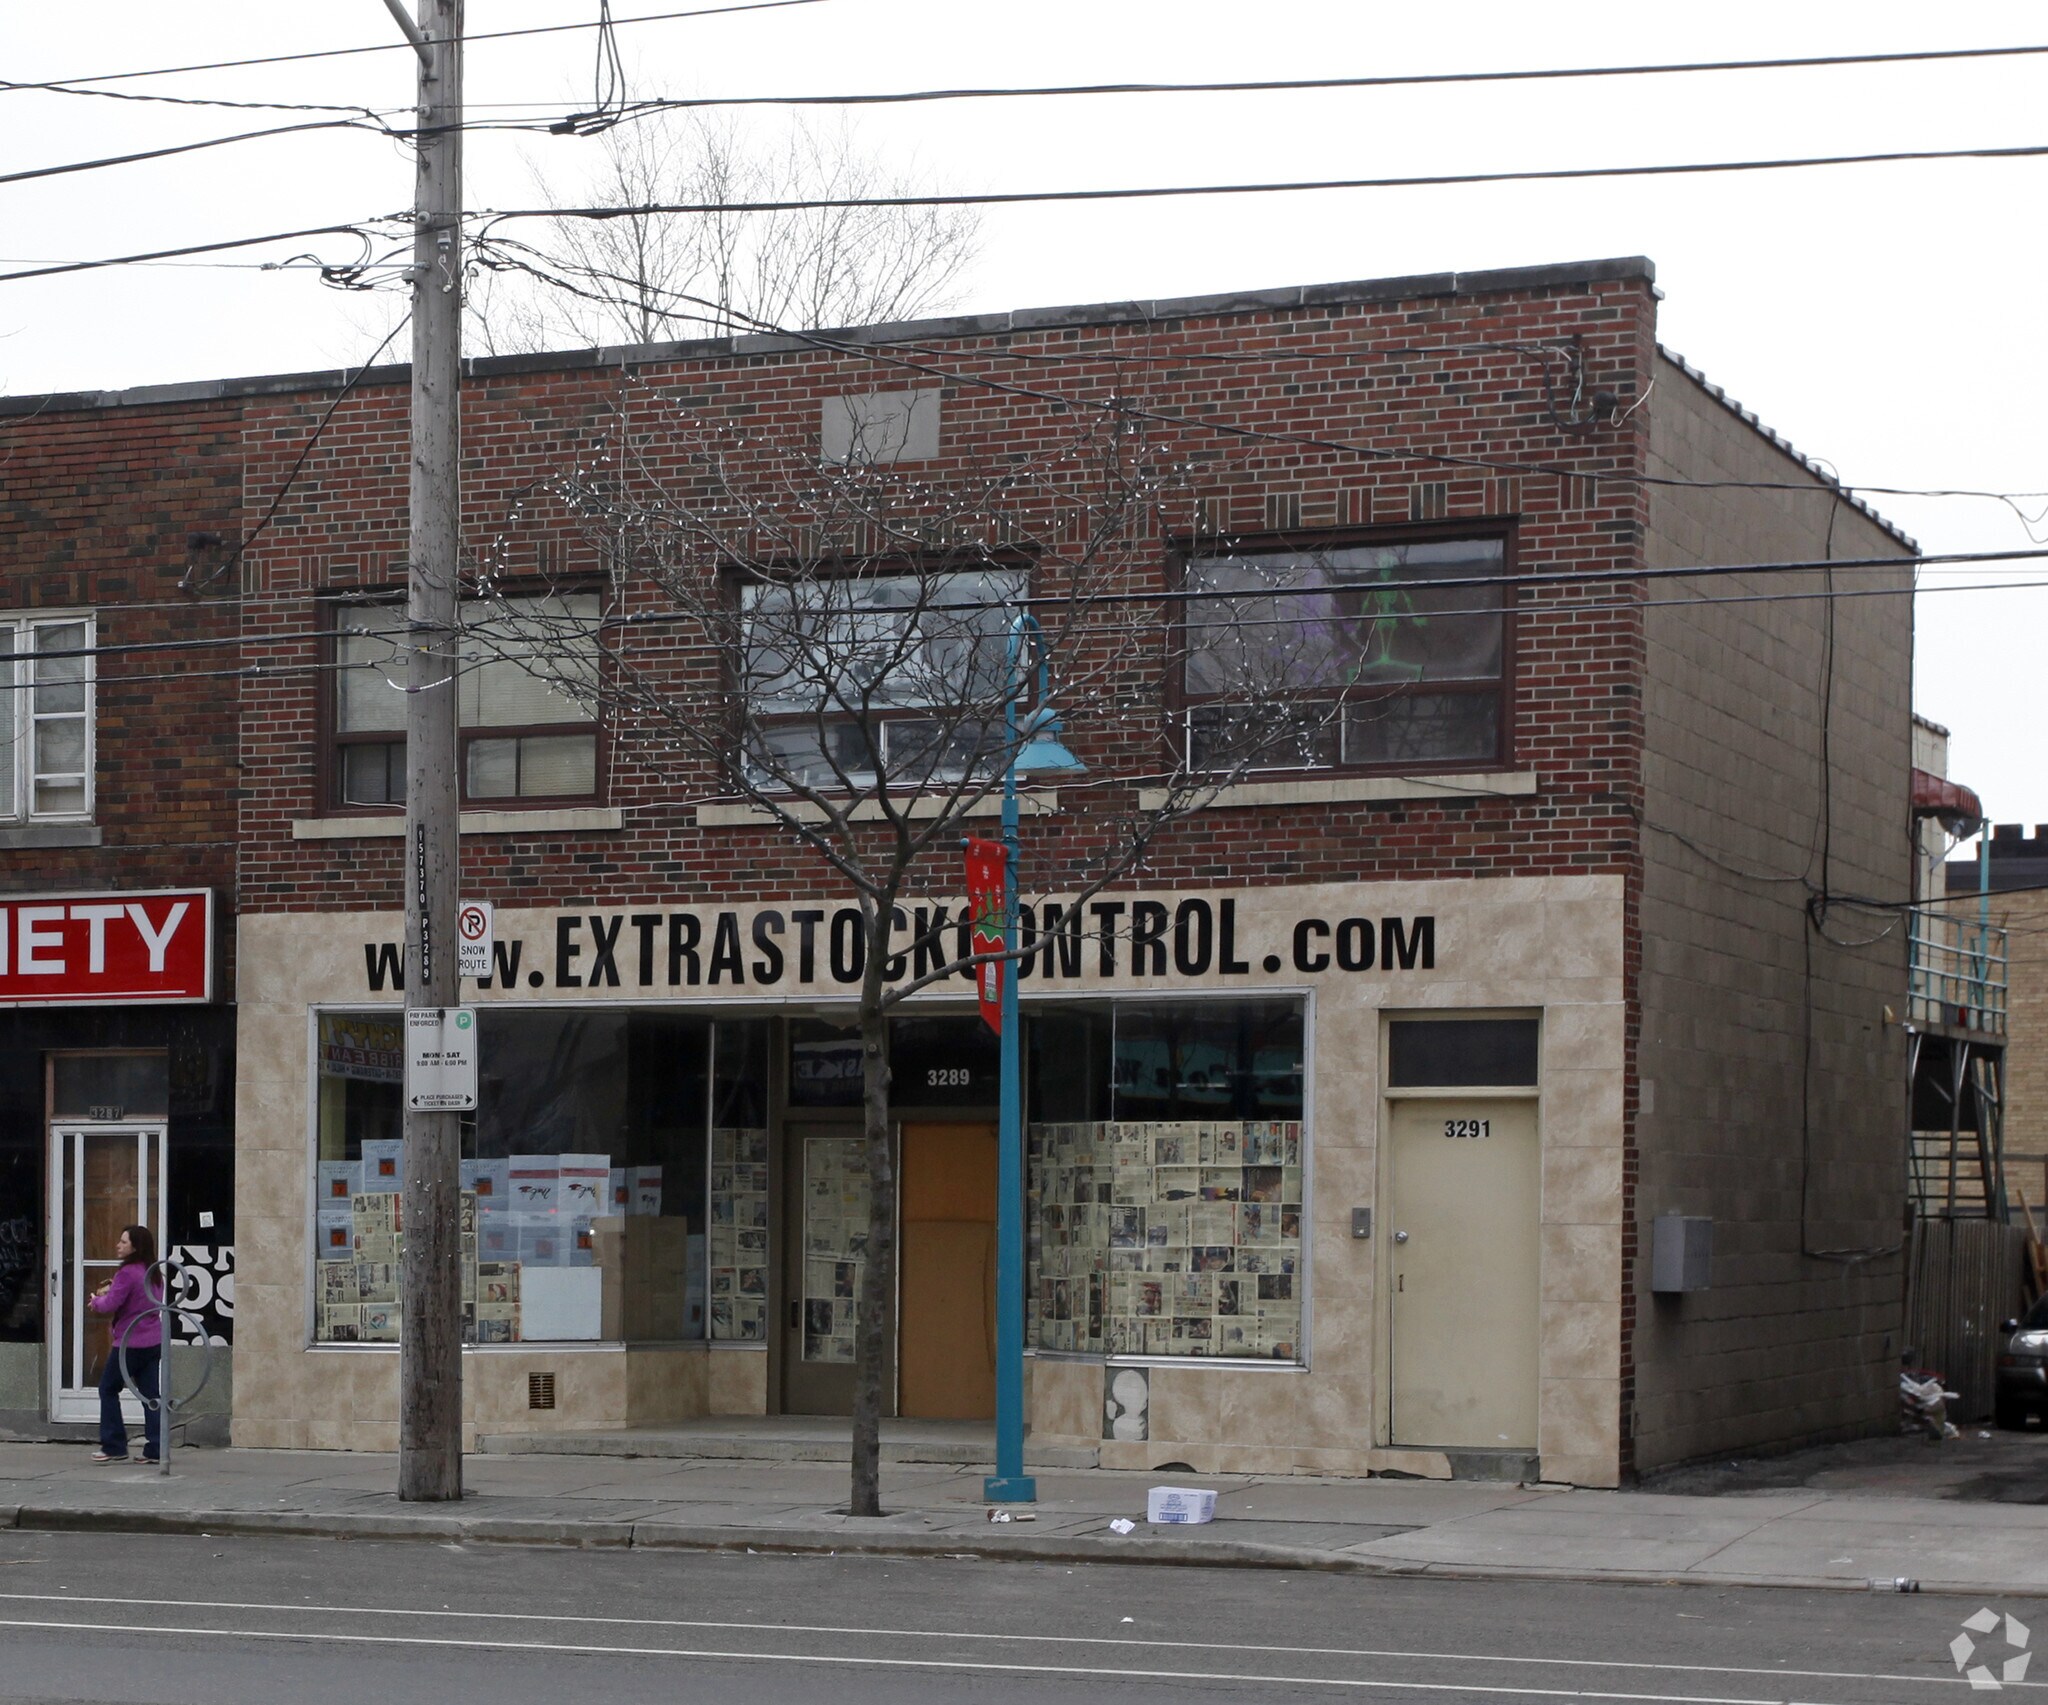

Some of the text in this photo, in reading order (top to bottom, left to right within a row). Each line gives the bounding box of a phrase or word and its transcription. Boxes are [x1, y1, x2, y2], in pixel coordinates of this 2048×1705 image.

[364, 898, 1435, 991] ww.EXTRASTOCKONTROL.COM
[422, 918, 431, 979] P3289
[461, 946, 486, 955] SNOW
[459, 960, 487, 969] ROUTE
[928, 1069, 970, 1086] 3289
[1444, 1120, 1490, 1138] 3291
